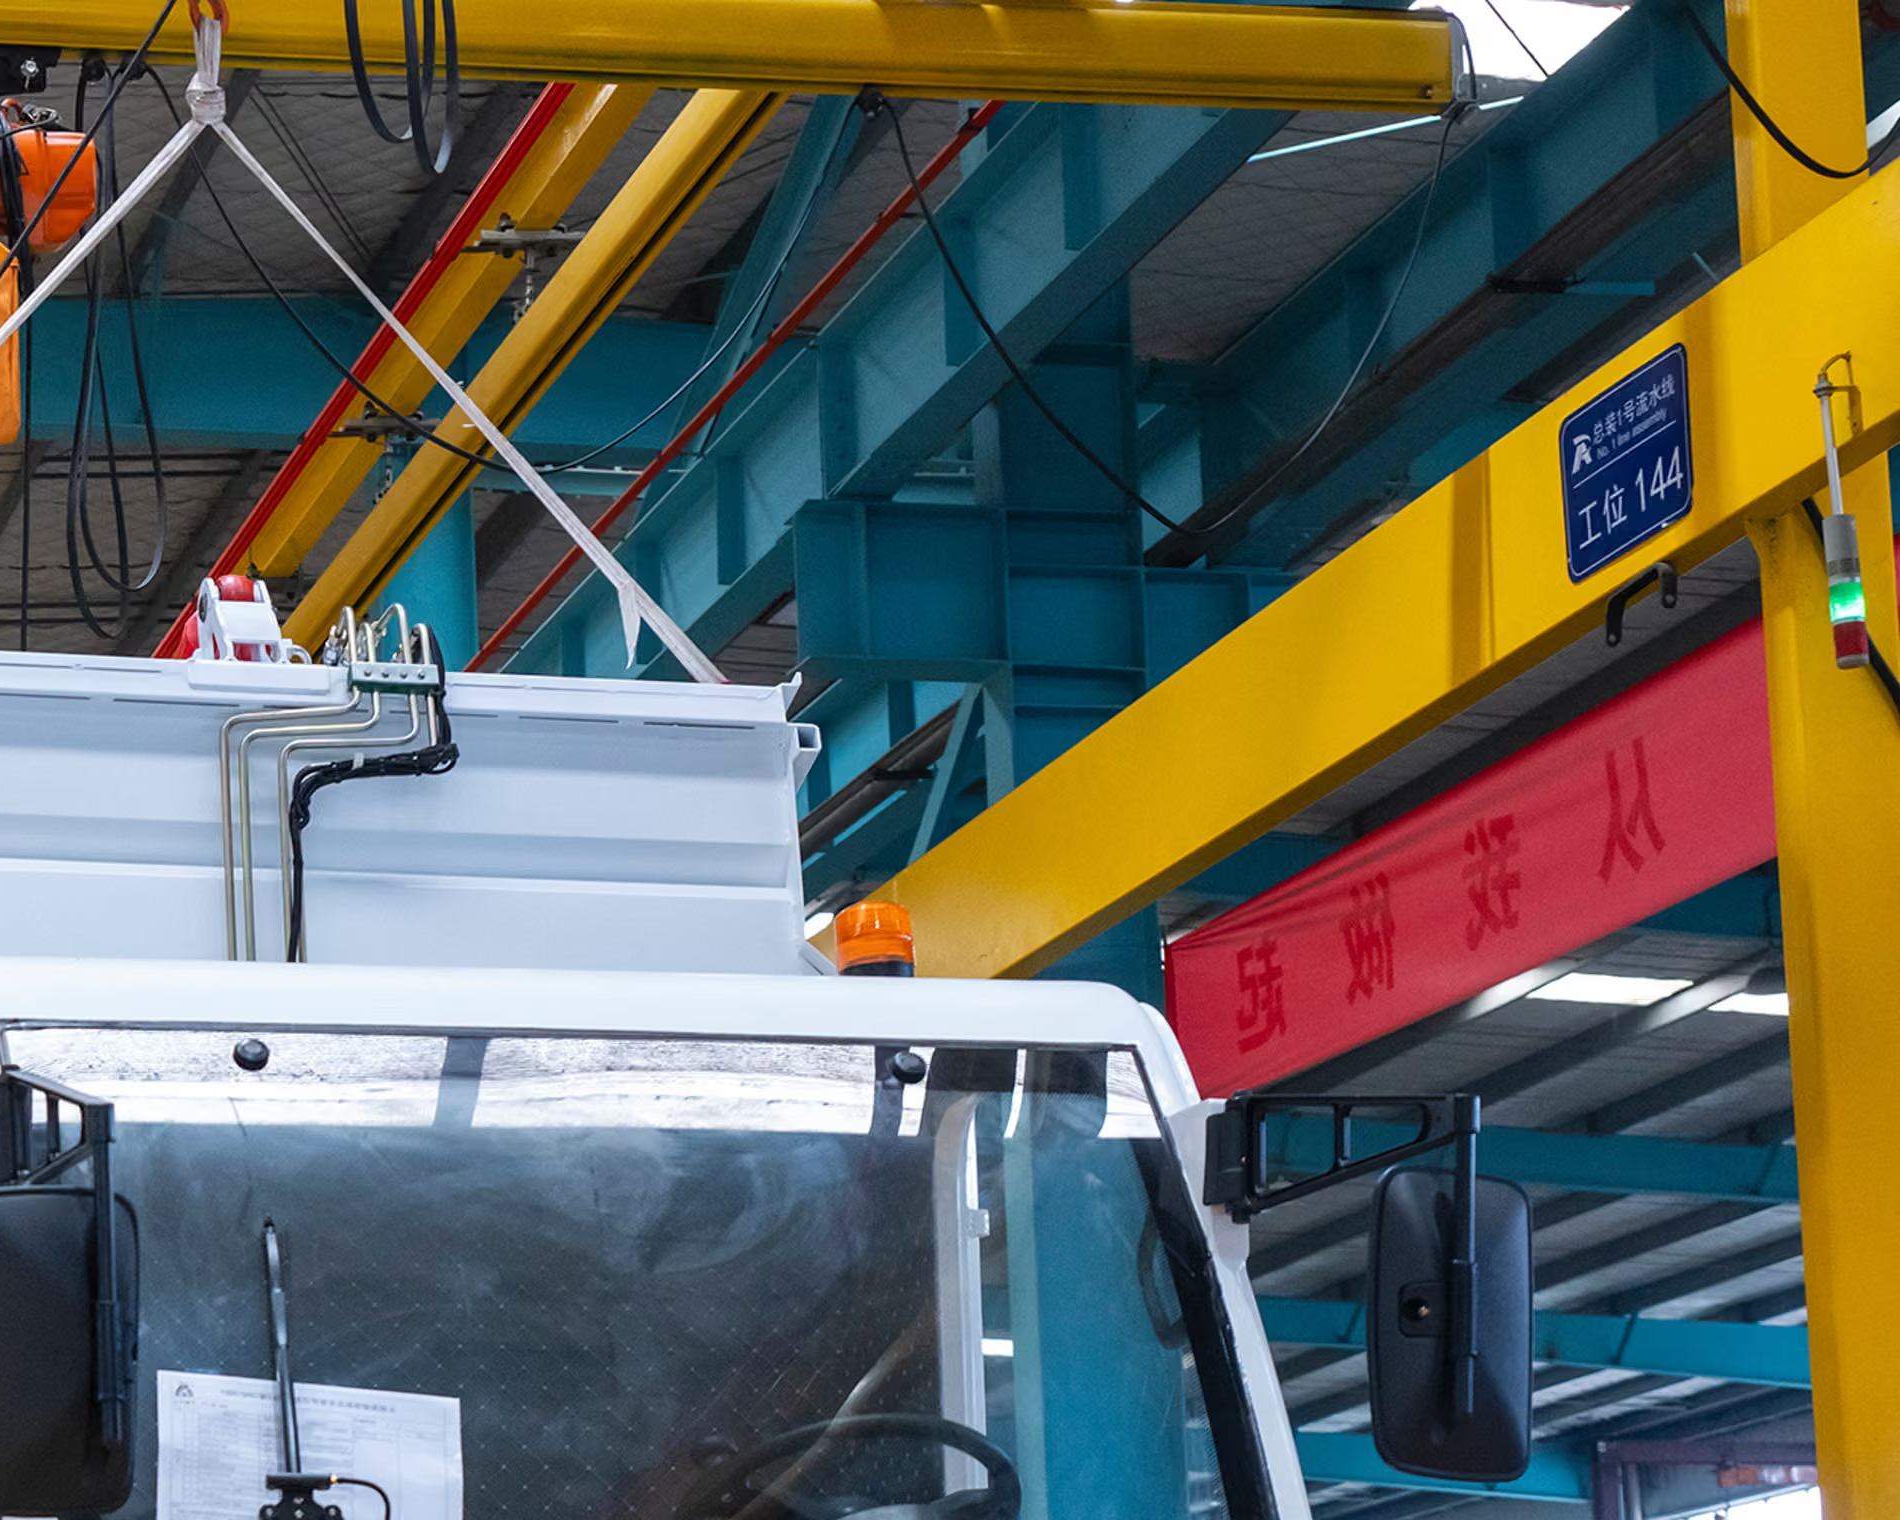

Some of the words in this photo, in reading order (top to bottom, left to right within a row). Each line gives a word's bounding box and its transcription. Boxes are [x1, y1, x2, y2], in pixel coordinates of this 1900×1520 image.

[1593, 374, 1675, 444] 总装1号流水线
[1578, 483, 1627, 549] 工位
[1635, 445, 1684, 512] 144
